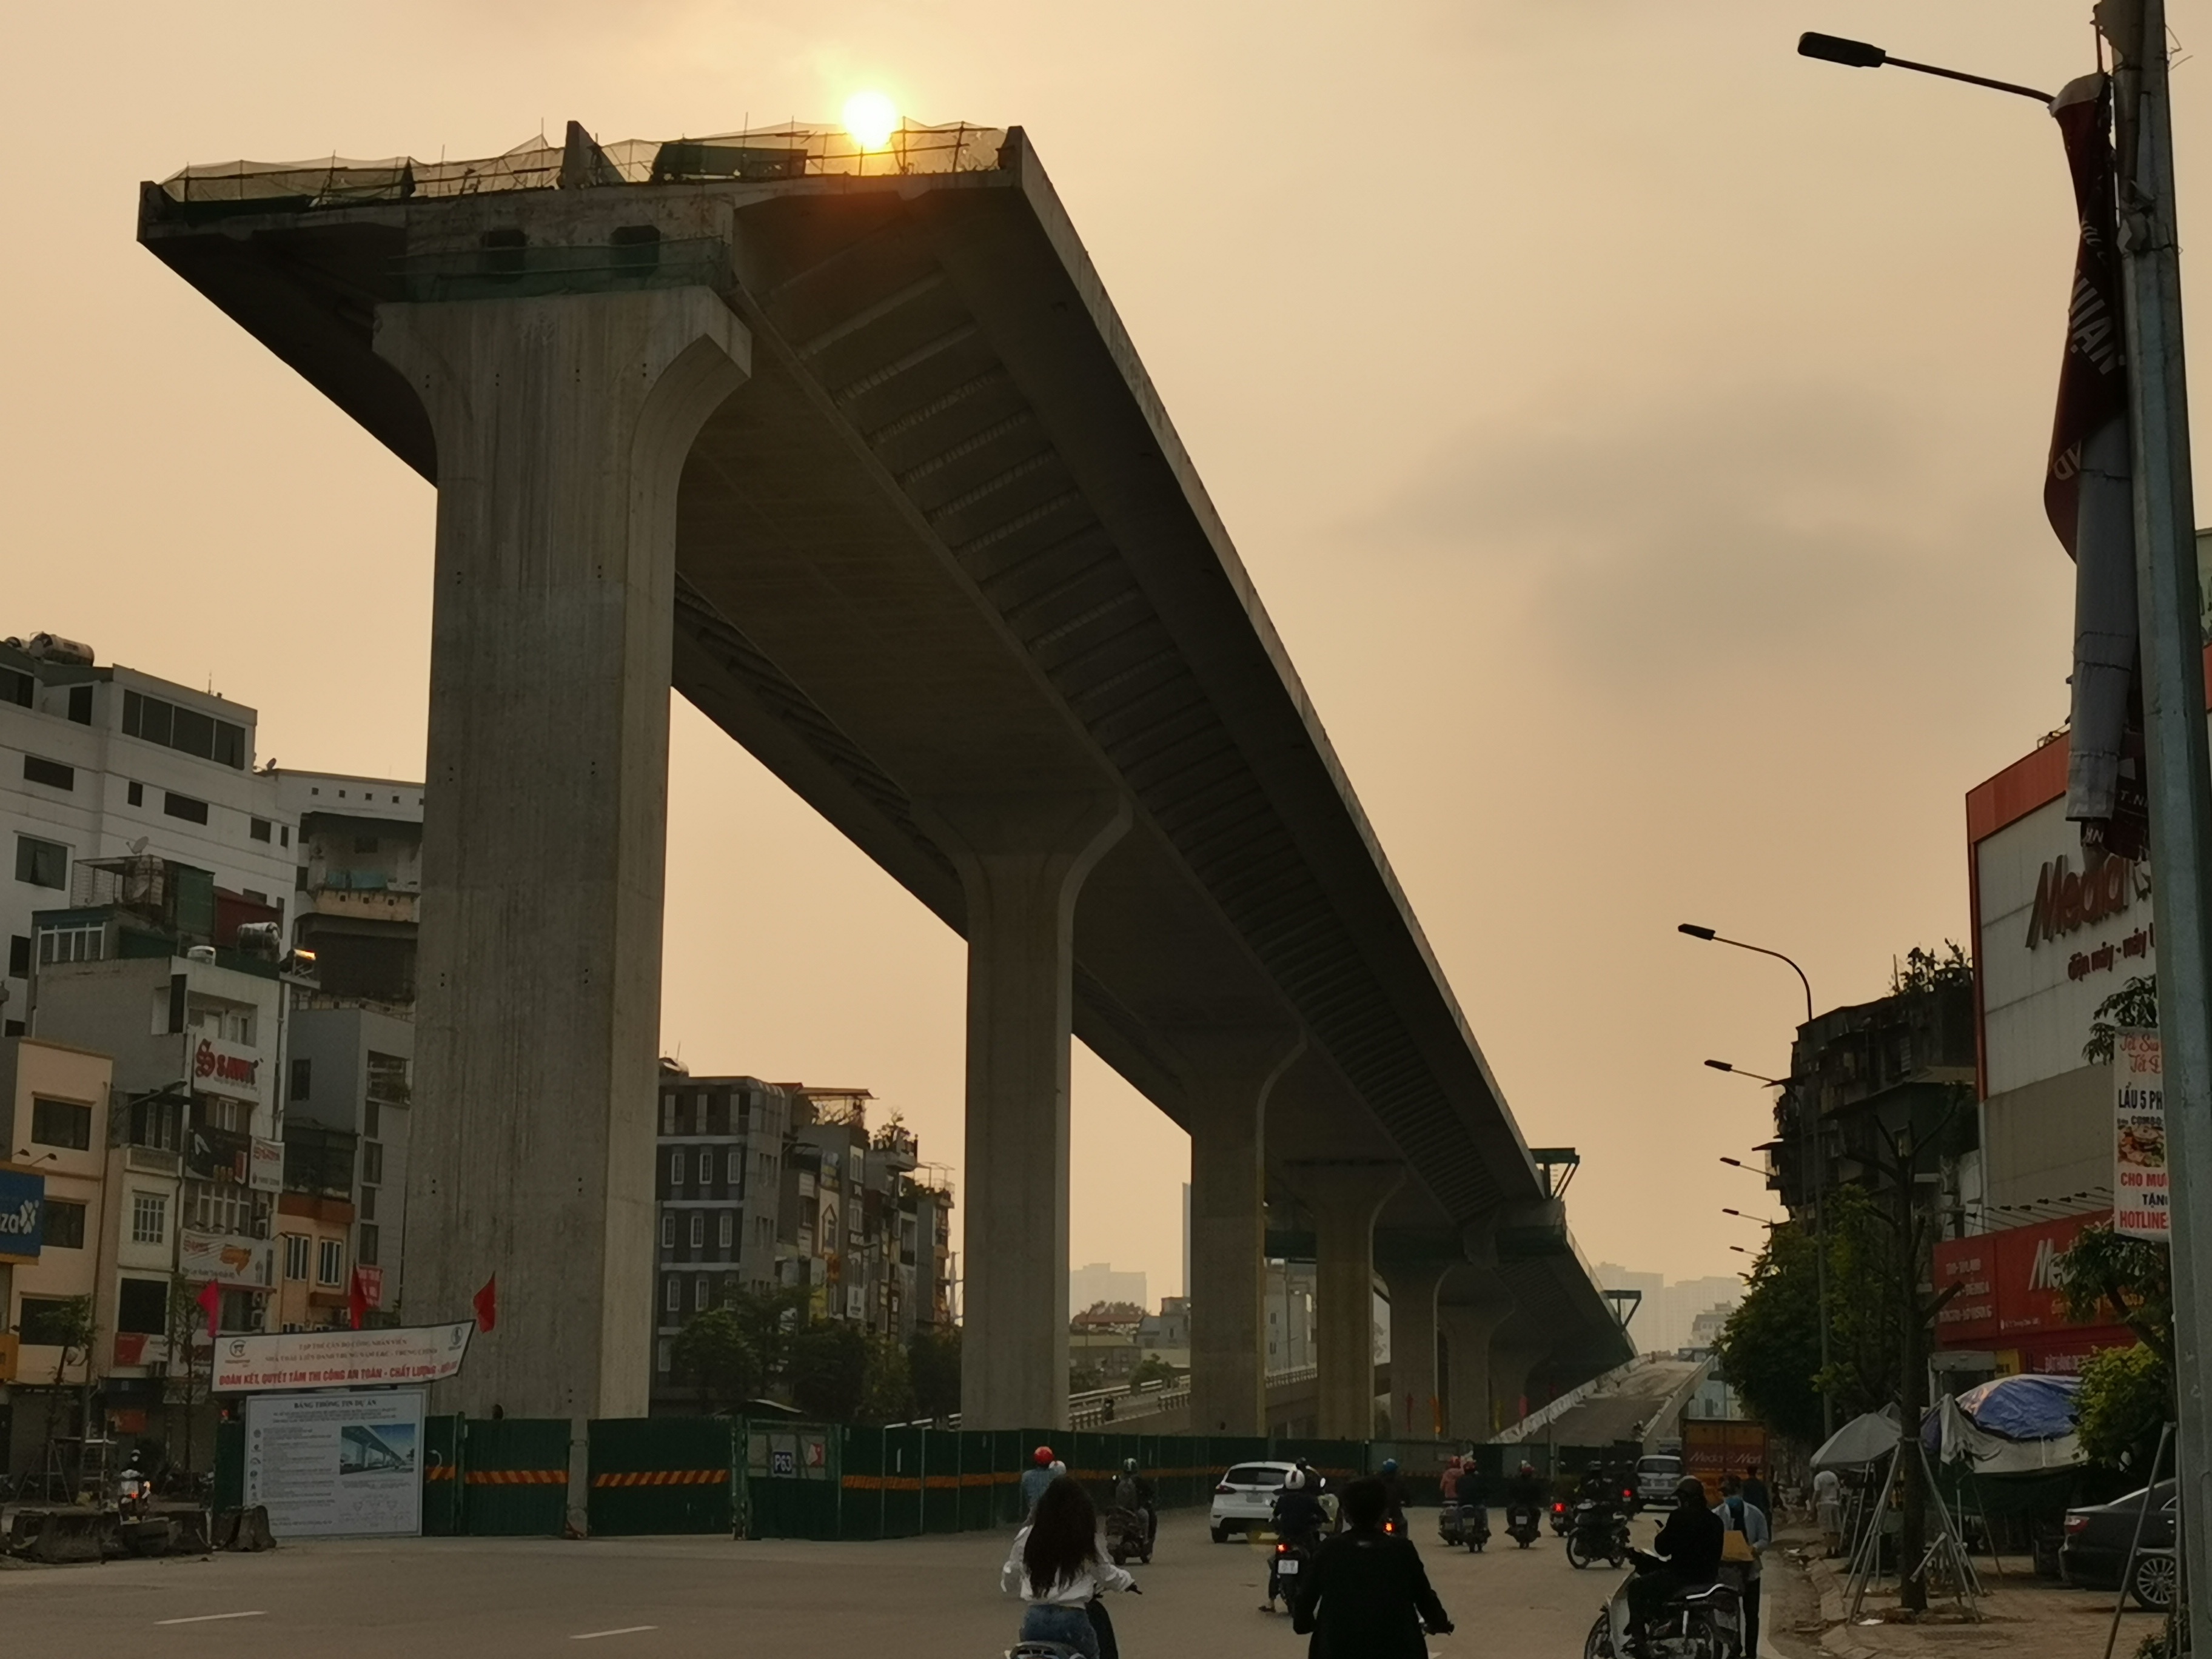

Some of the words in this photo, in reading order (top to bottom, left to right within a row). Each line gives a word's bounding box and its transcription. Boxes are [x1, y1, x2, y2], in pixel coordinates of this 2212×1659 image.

[2140, 1090, 2147, 1110] 5
[2120, 1172, 2143, 1187] CHO
[309, 1371, 321, 1382] THI
[323, 1368, 345, 1381] CÔNG
[347, 1369, 359, 1379] AN
[774, 1454, 792, 1472] P63
